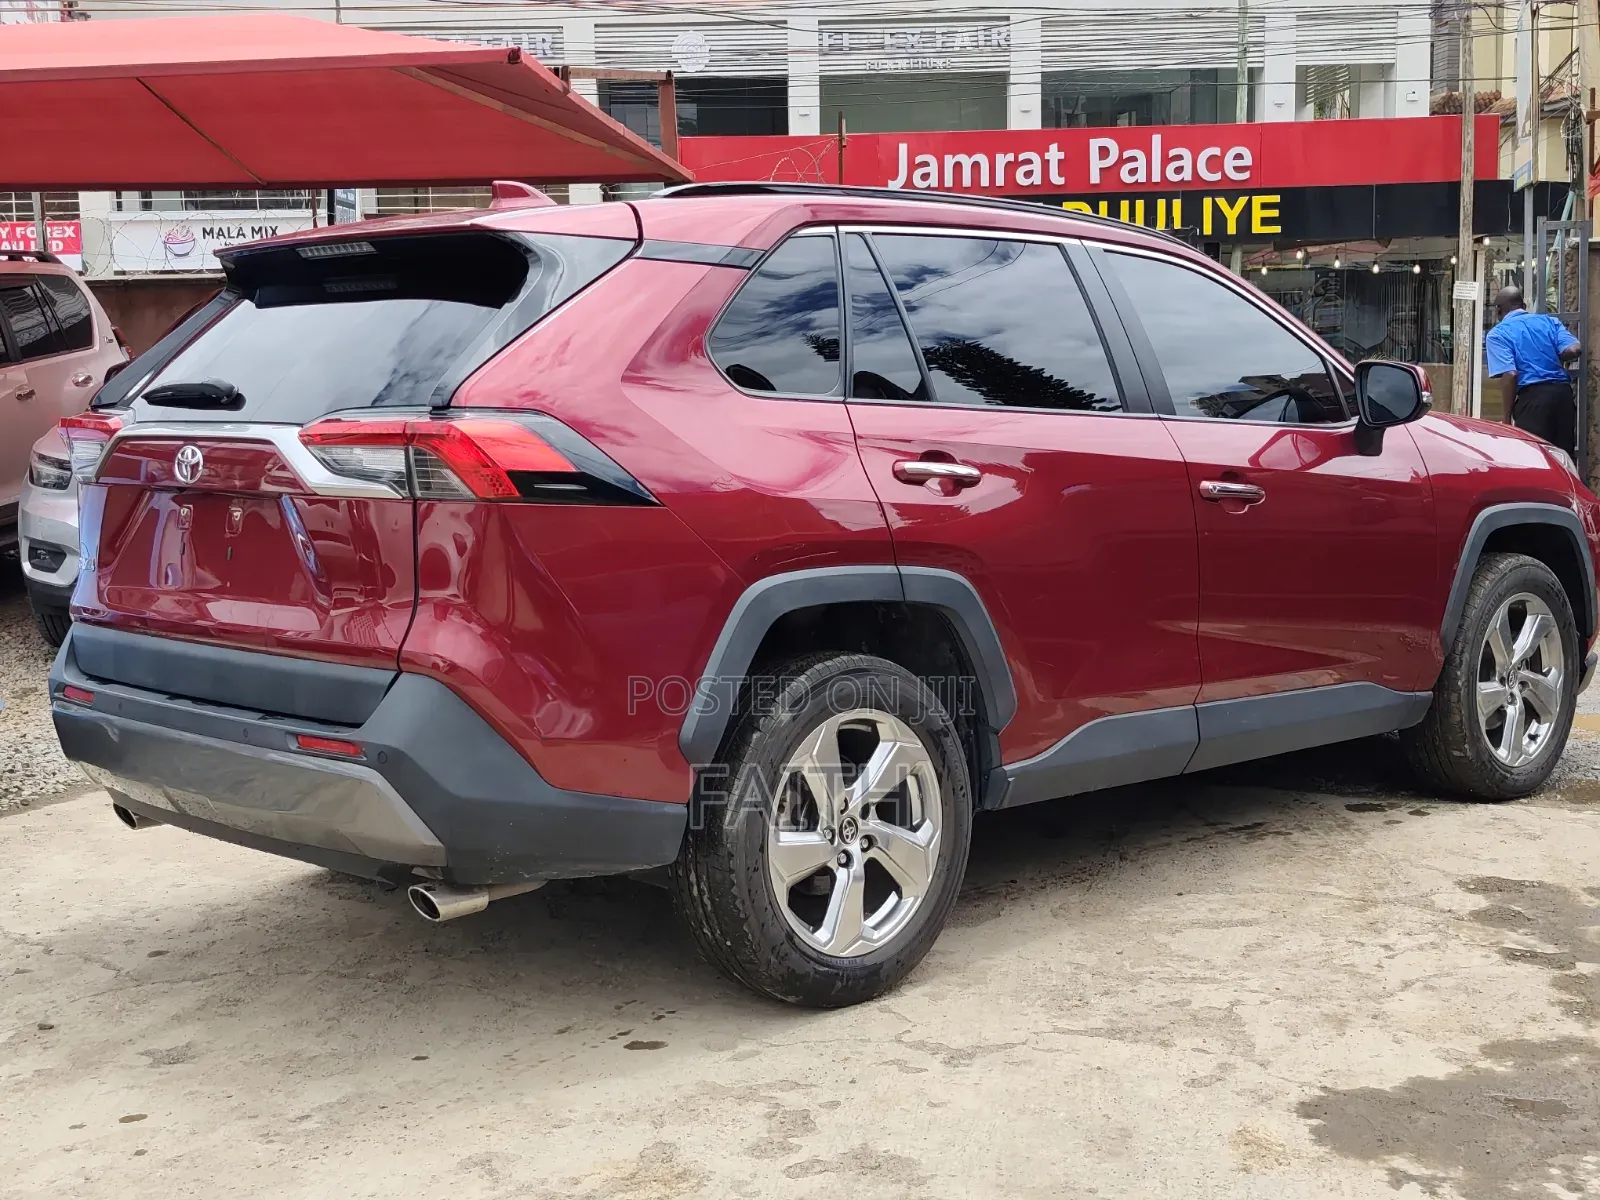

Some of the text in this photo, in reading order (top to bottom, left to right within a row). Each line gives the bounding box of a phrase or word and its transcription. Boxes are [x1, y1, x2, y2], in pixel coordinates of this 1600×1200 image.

[888, 133, 1253, 190] Jamrat Palace
[202, 225, 279, 240] MALA MIX
[30, 240, 64, 252] LD
